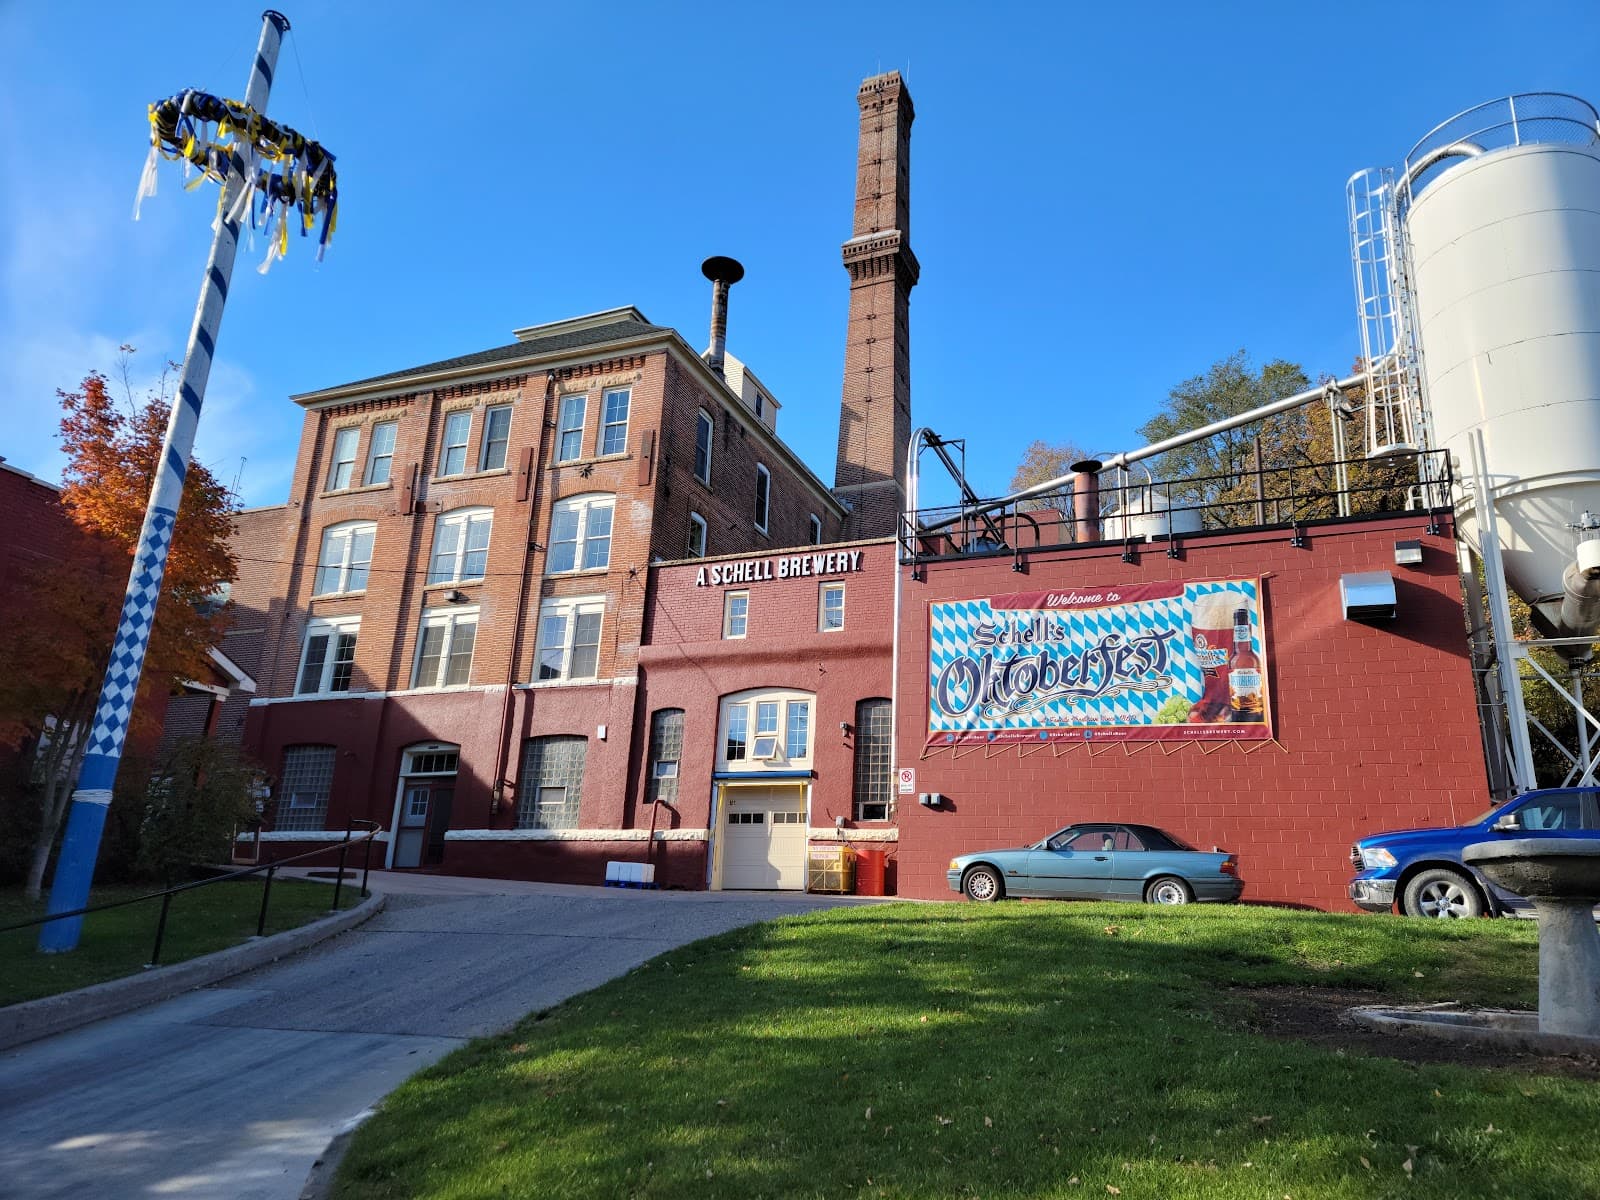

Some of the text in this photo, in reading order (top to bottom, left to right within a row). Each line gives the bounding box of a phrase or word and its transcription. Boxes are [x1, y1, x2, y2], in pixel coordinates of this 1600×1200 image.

[711, 559, 773, 585] SCHELL
[1047, 591, 1121, 607] Welcome to
[973, 616, 1065, 646] Schell's
[937, 628, 1177, 717] Oktoberfest
